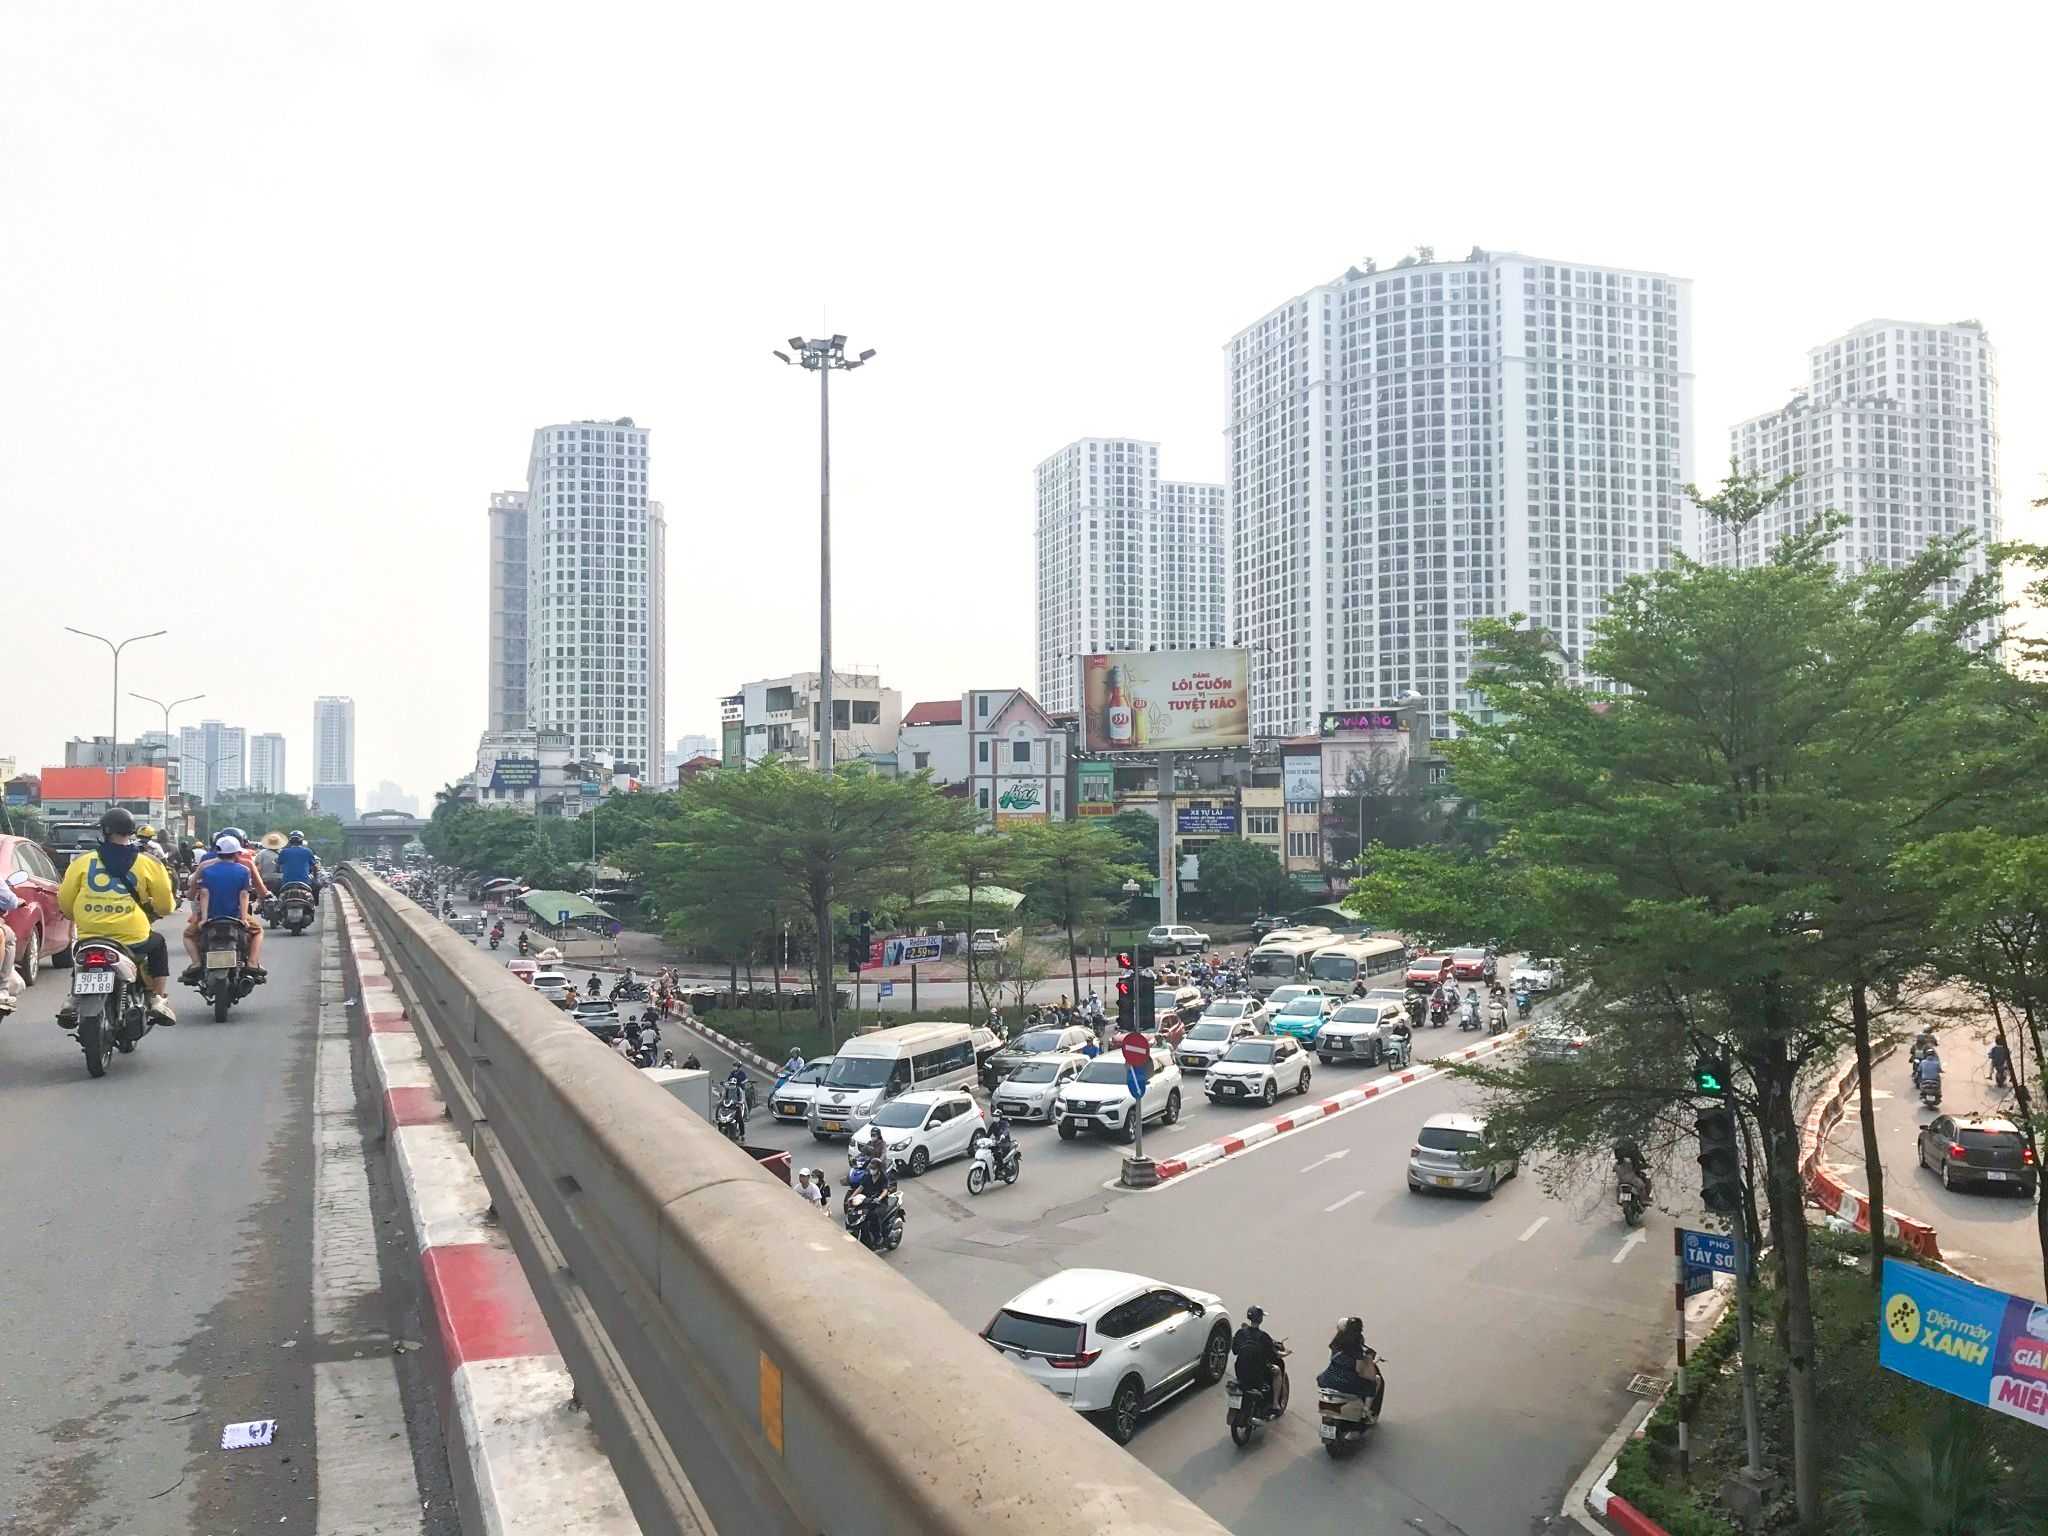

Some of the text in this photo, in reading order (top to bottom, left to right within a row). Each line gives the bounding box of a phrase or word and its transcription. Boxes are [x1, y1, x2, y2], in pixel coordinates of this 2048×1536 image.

[1172, 677, 1232, 691] LÔI CUỐN
[1168, 697, 1237, 712] TUYỆT HẢO
[1201, 809, 1210, 817] TỰ
[909, 938, 926, 948] Redmi
[911, 946, 928, 959] 2.59
[81, 973, 109, 983] 90-B3
[76, 983, 111, 993] 371.88
[1709, 1240, 1730, 1250] PHỐ
[1688, 1247, 1737, 1268] TÂY SƠ
[1926, 1308, 1993, 1343] Điện máy
[1919, 1326, 1990, 1366] XANH
[2014, 1348, 2042, 1369] GIÁ
